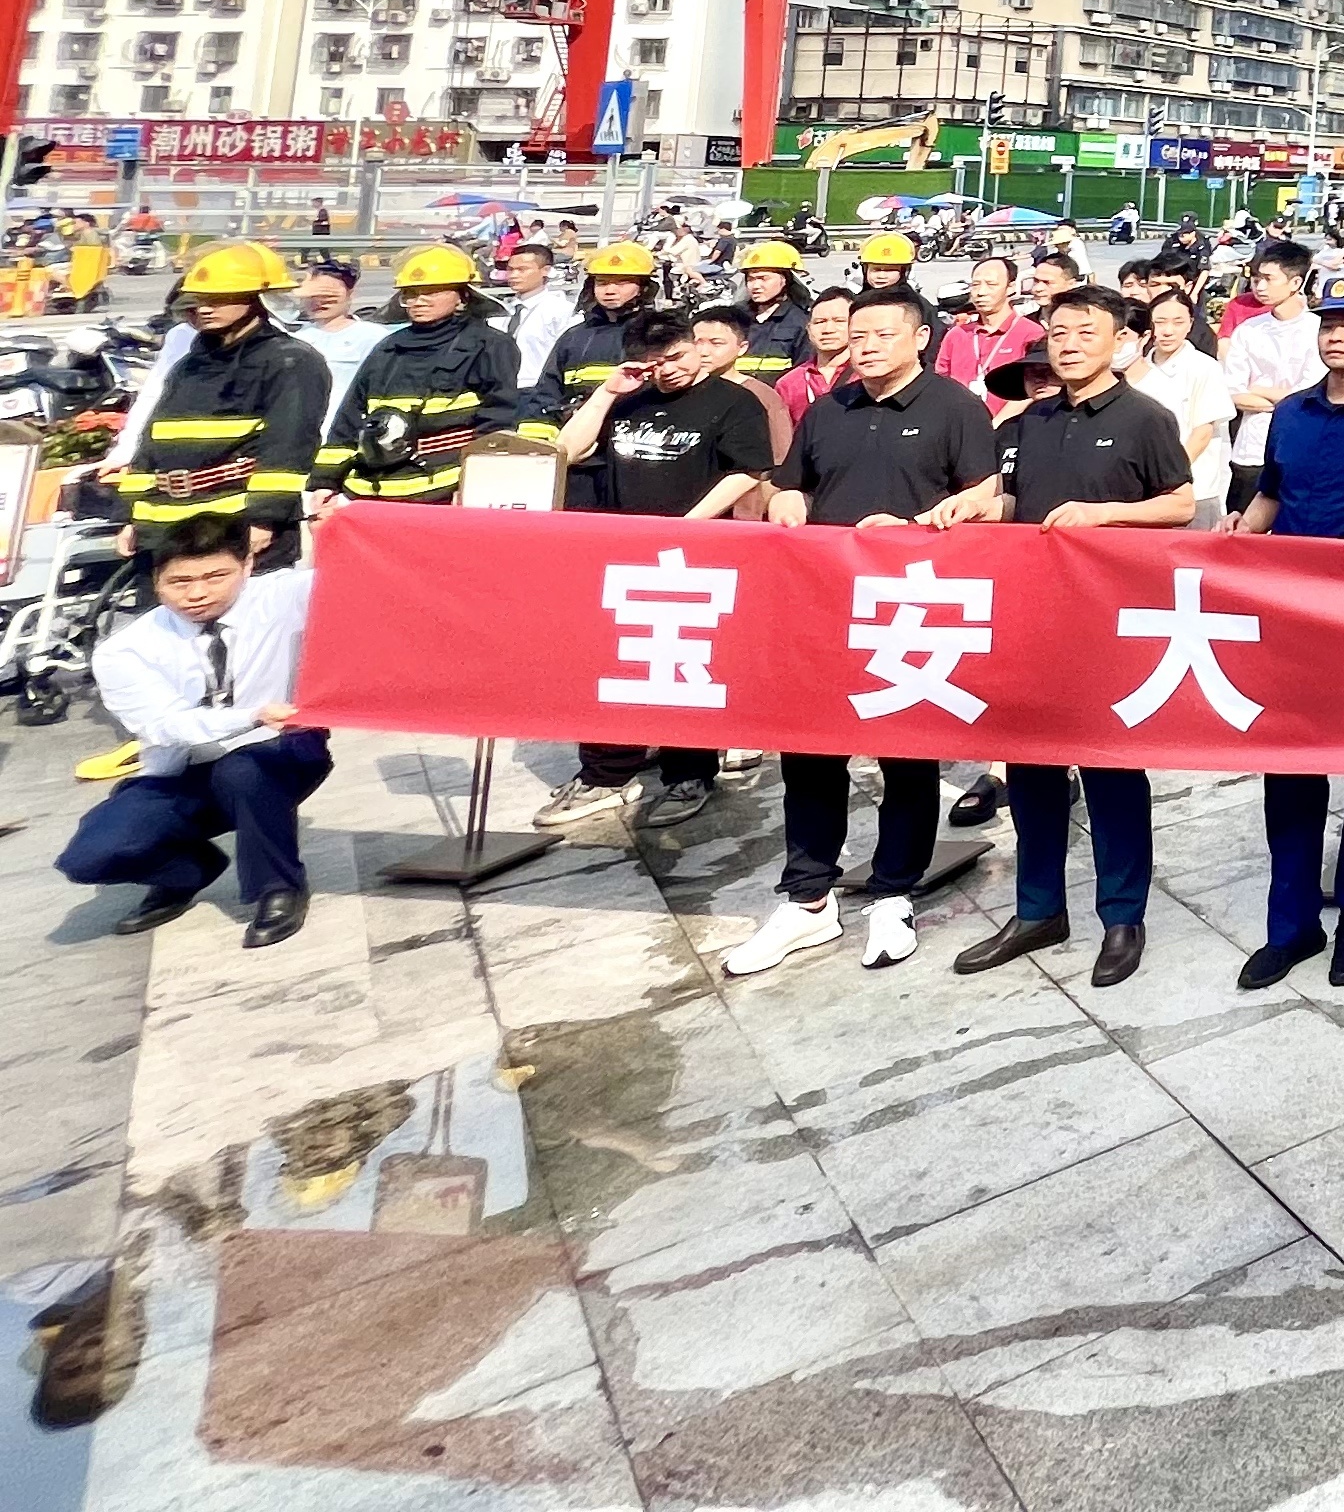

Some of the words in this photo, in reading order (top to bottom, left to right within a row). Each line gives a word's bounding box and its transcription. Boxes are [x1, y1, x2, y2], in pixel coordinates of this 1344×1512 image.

[151, 124, 318, 163] 潮州砂锅粥
